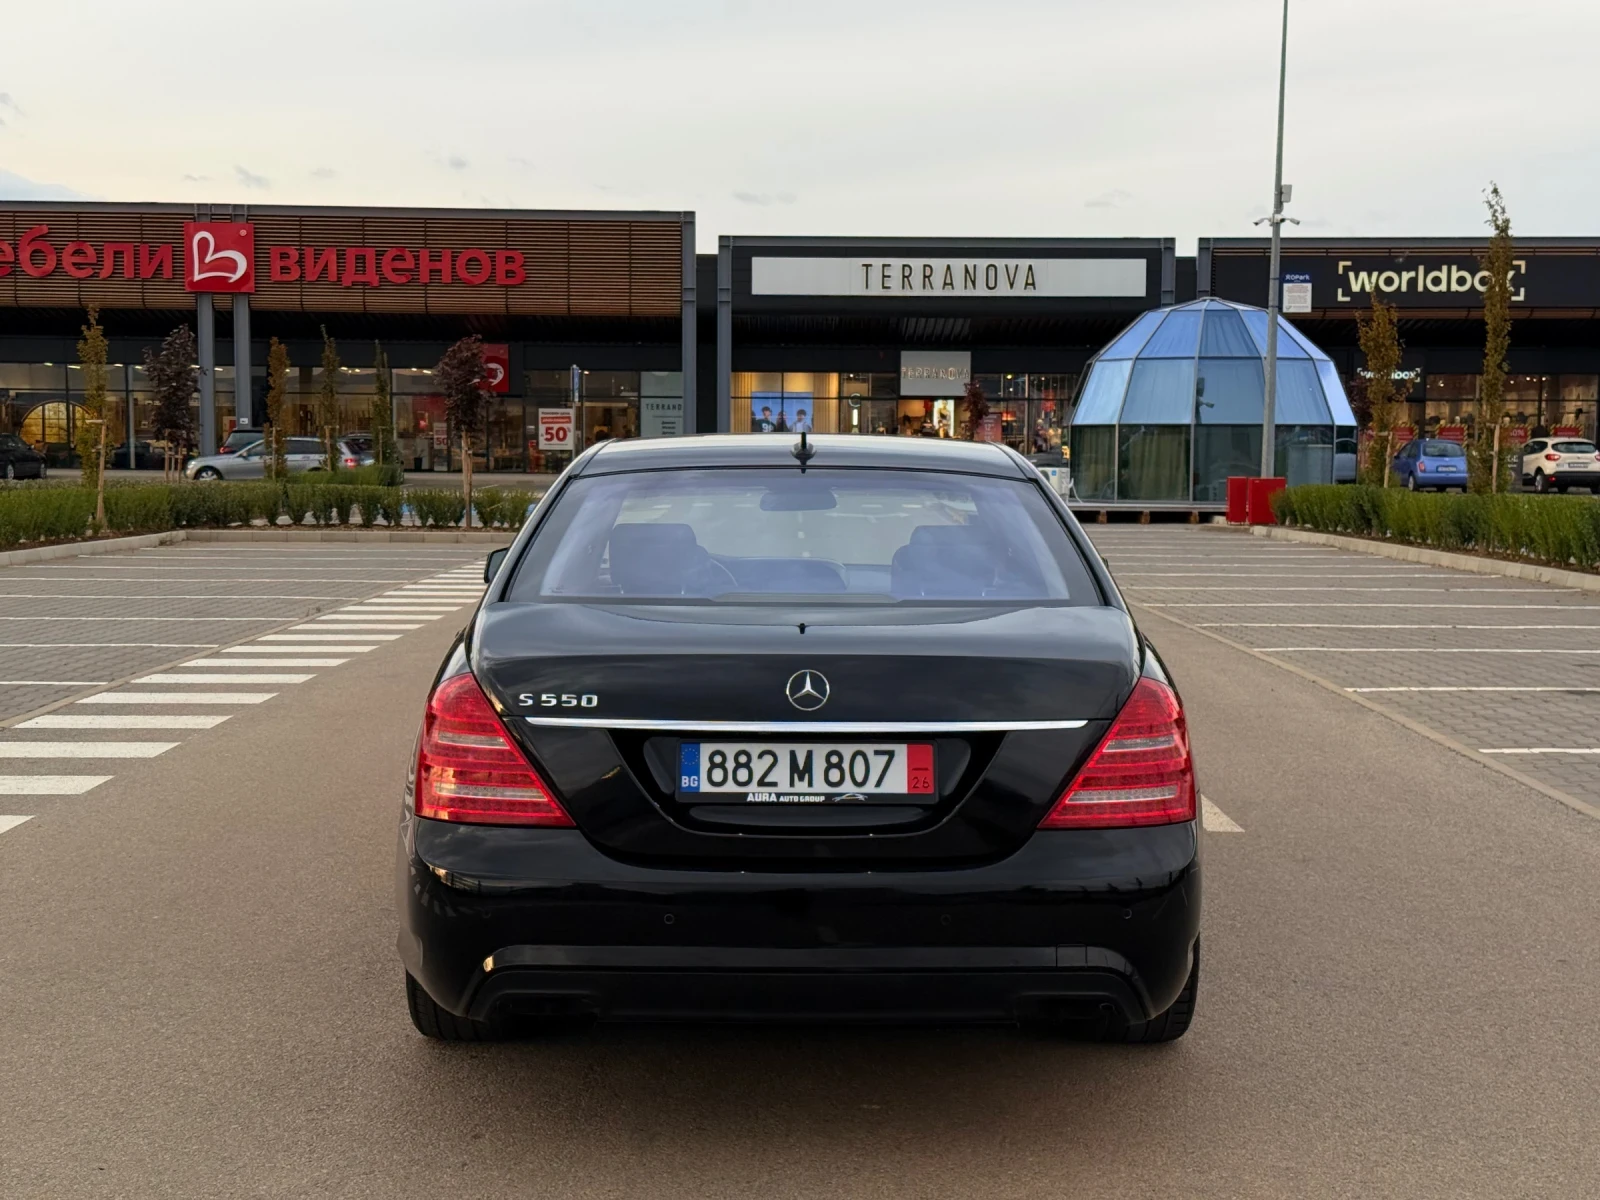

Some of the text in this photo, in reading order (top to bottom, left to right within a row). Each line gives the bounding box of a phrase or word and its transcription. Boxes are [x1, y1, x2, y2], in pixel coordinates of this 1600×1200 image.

[269, 246, 526, 287] виденов
[861, 263, 1037, 291] TERRANOVA
[901, 366, 970, 380] TERRANOVA
[518, 693, 598, 708] S 550
[681, 749, 930, 790] BG 882 M 807 26
[746, 792, 826, 803] AURA AUTO GROUP
